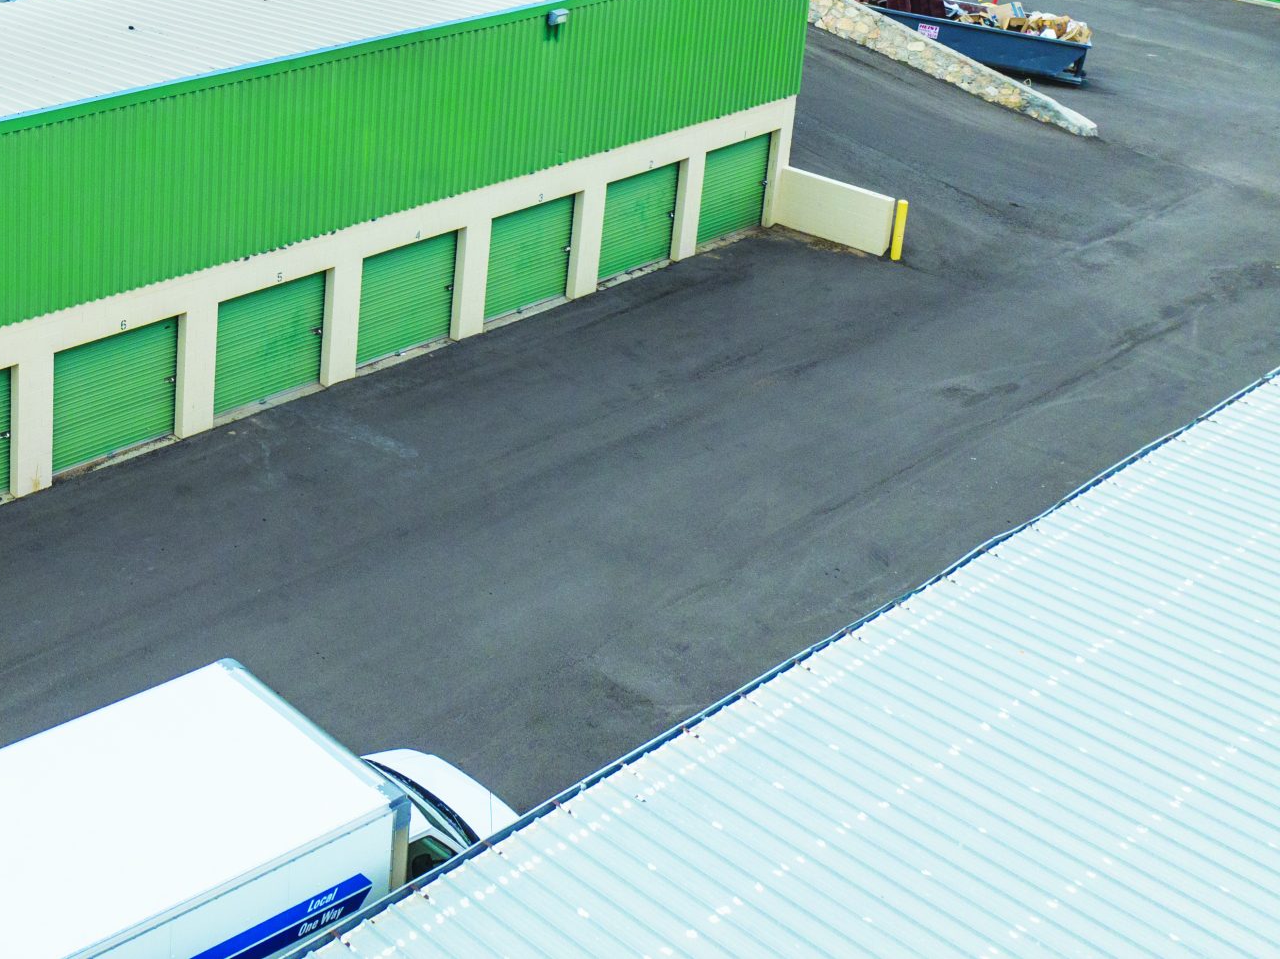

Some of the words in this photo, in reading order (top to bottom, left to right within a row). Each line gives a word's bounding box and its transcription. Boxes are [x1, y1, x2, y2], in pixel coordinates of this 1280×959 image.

[538, 193, 544, 203] 3
[277, 272, 283, 282] 5
[120, 319, 127, 331] 6
[307, 887, 338, 913] Local
[297, 919, 319, 937] One
[320, 906, 345, 925] Way
